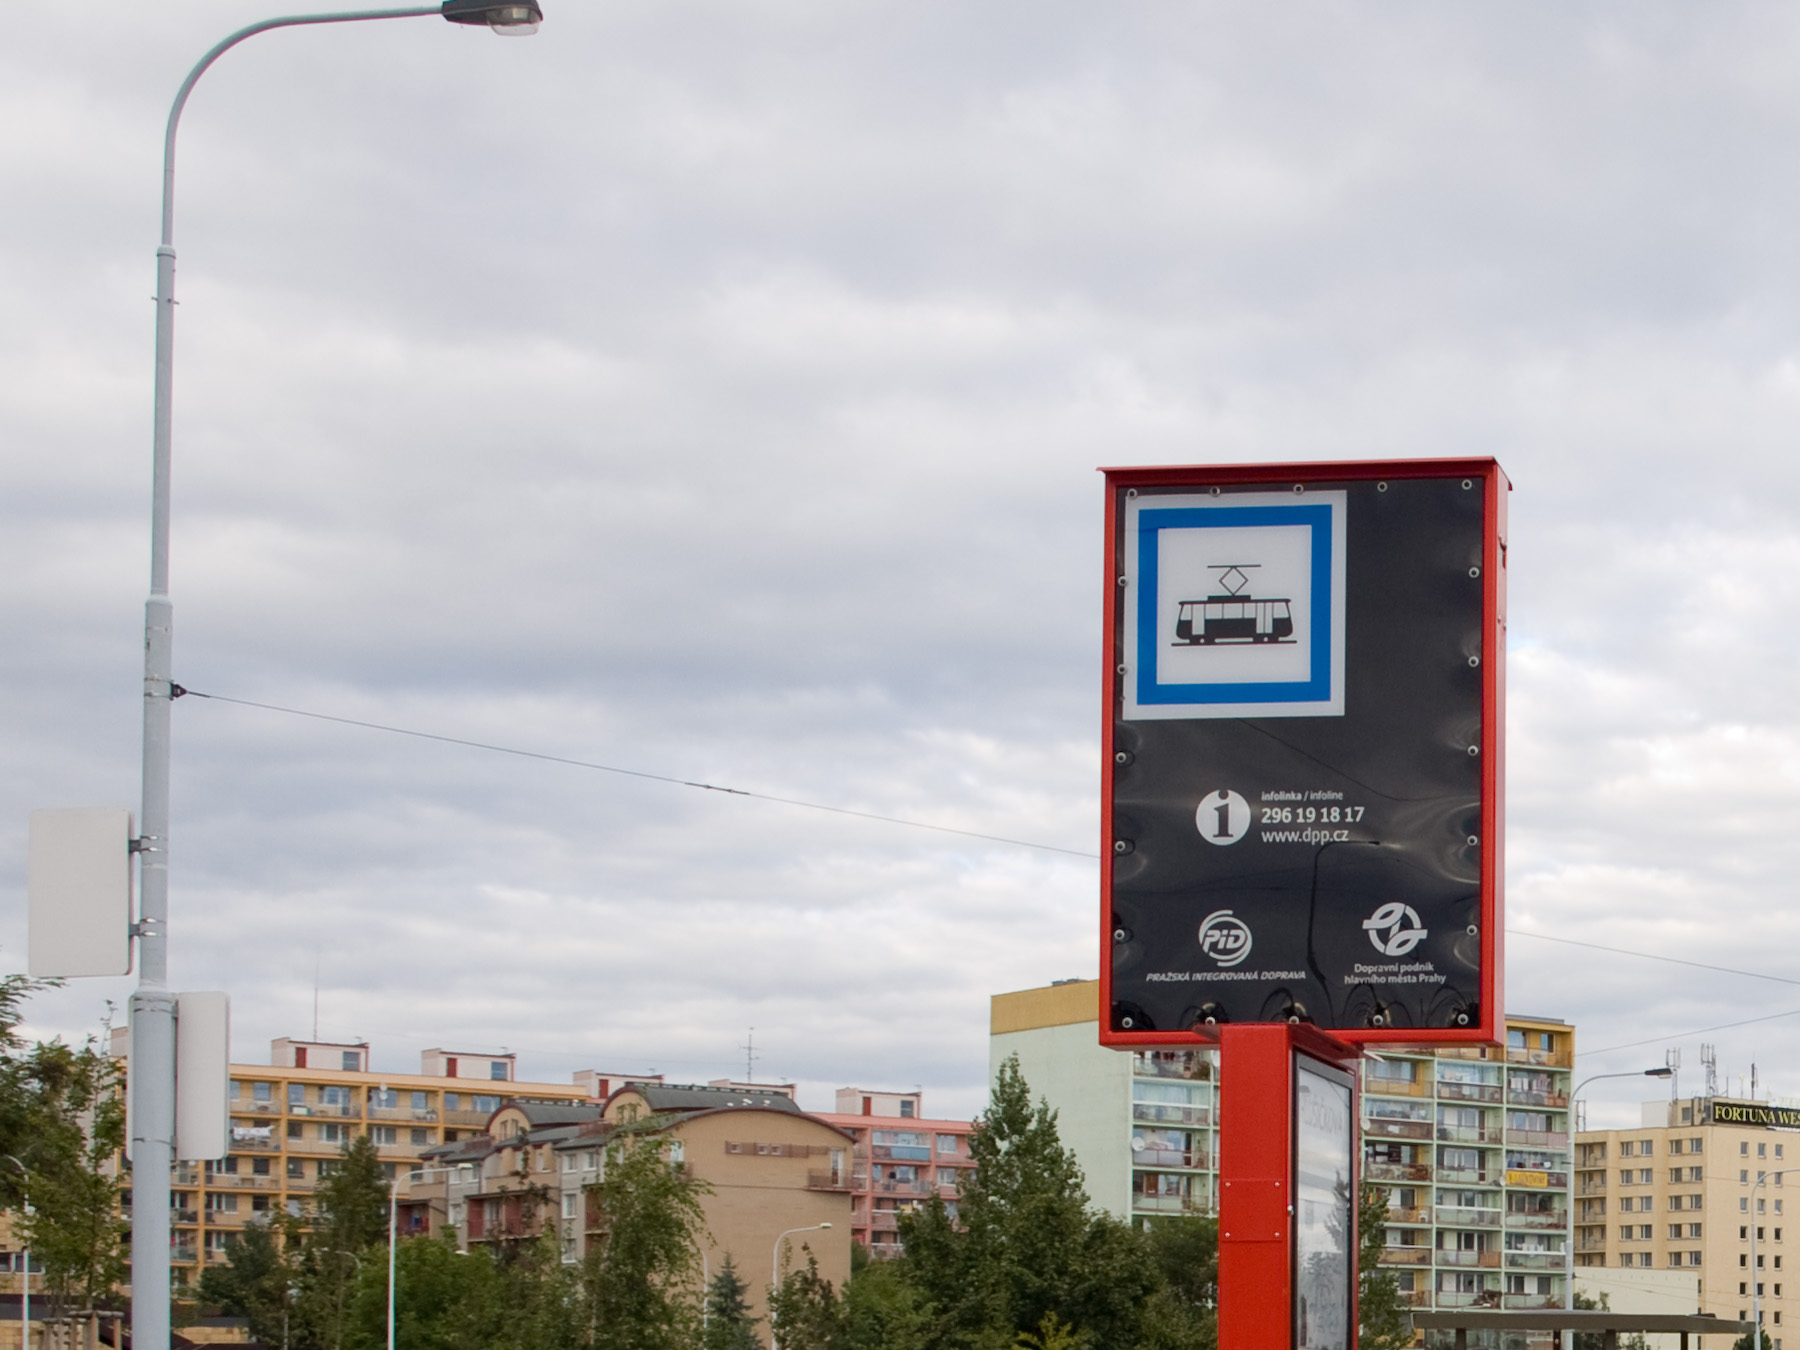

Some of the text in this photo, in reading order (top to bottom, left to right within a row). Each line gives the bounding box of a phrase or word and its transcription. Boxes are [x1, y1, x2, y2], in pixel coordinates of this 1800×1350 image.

[1261, 791, 1302, 801] infolinka
[1310, 790, 1344, 800] infoline
[1261, 806, 1365, 823] 296 19 18 17
[1261, 827, 1349, 845] www.dpp.cz
[1354, 962, 1434, 974] Dopravní podnik
[1146, 970, 1306, 982] PRAŽSKÁ INTEGROVANÁ DOPRAVA
[1344, 973, 1446, 984] hlavního města Prahy
[1715, 1105, 1776, 1123] FORTUNA
